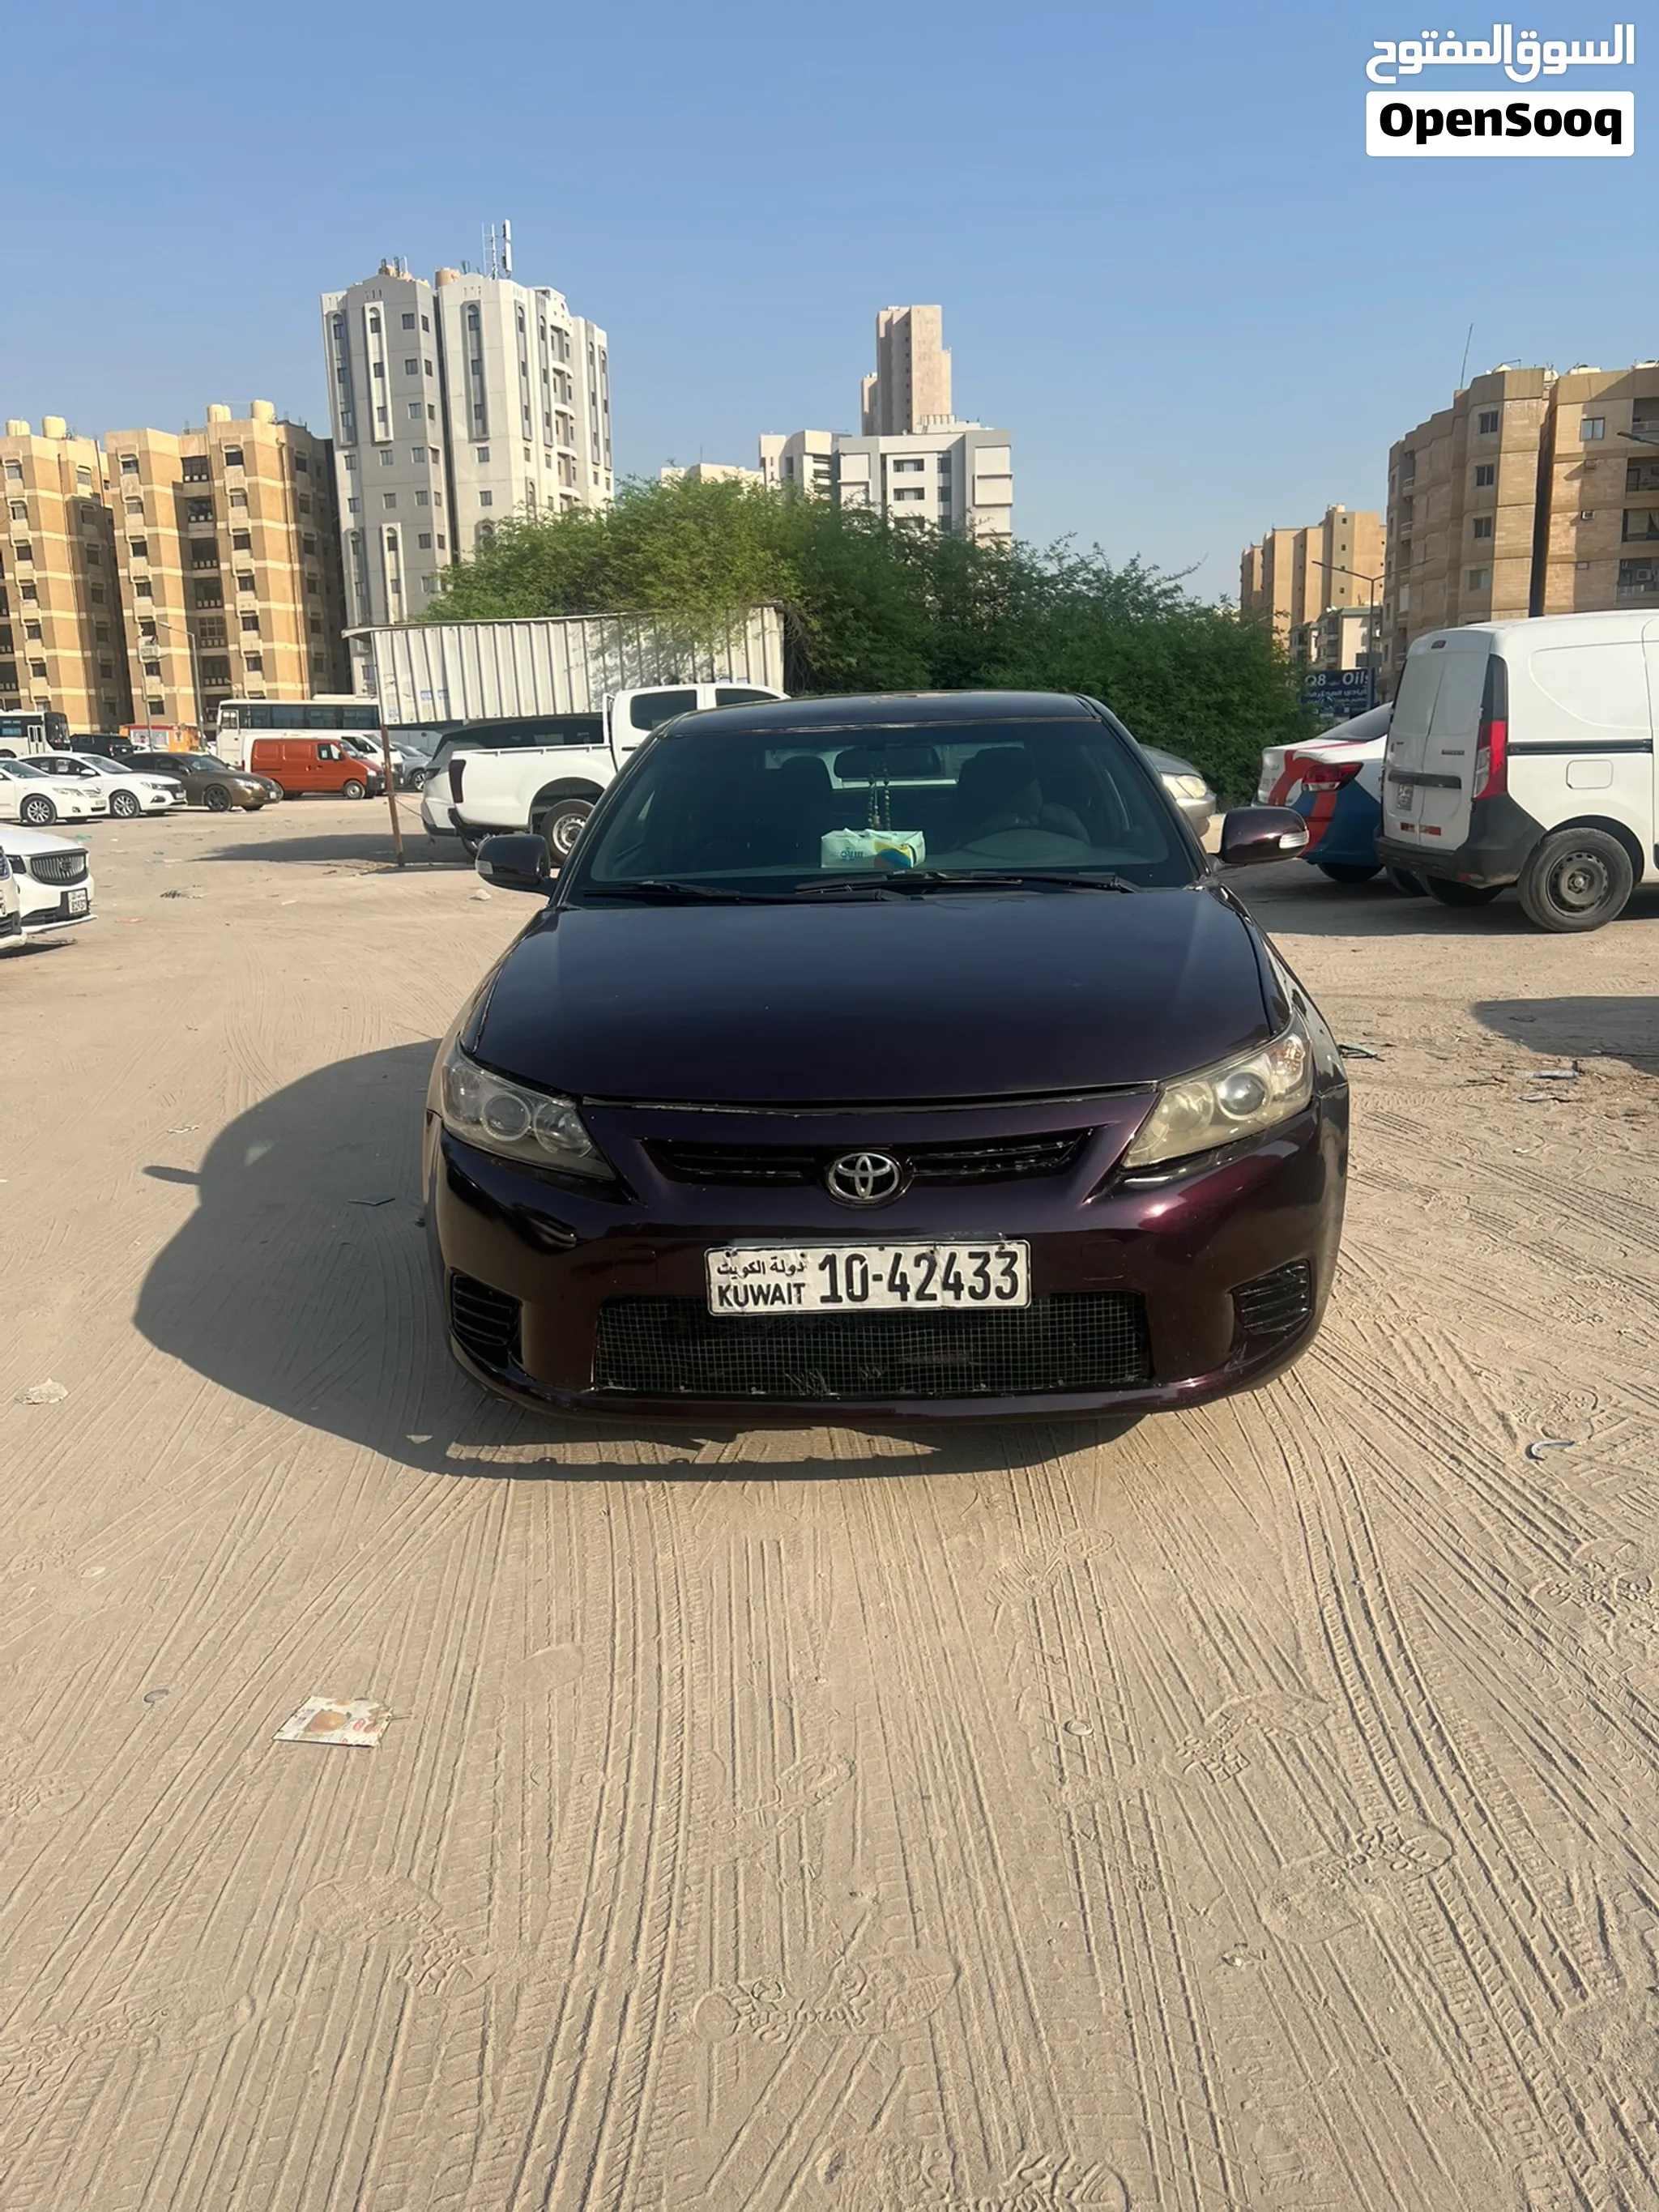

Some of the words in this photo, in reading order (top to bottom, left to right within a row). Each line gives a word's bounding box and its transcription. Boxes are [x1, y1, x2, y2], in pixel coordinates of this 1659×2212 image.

[717, 1259, 766, 1280] الكويت
[770, 1255, 807, 1276] دولة
[818, 1251, 1019, 1303] 10-42433
[717, 1282, 806, 1307] KUWAIT
